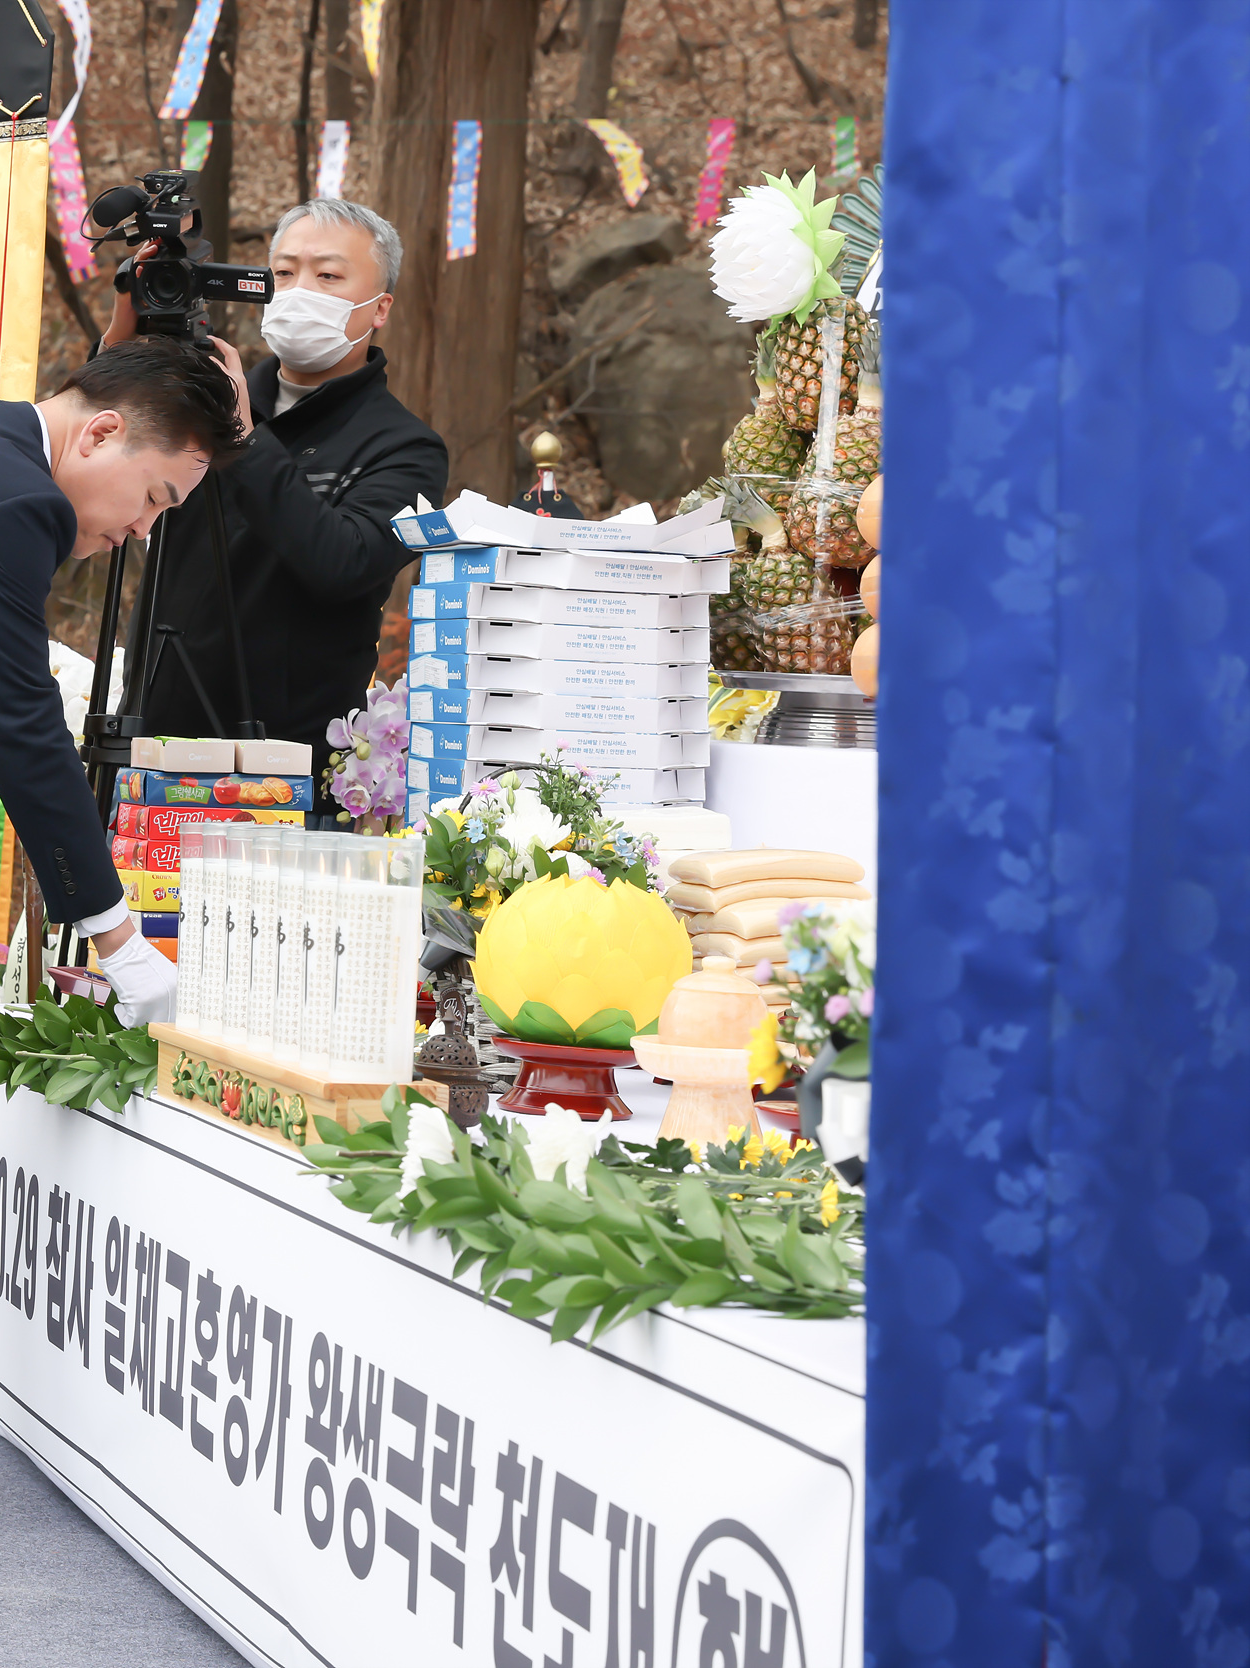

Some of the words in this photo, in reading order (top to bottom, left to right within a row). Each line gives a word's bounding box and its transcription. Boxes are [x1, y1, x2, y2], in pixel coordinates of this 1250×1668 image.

[239, 280, 264, 291] BTN
[468, 564, 490, 574] Domino's
[445, 599, 462, 609] Domino's
[448, 670, 461, 680] mino's
[445, 740, 462, 750] Domino's
[153, 811, 204, 836] 빅파이
[46, 1184, 95, 1369] 참사
[105, 1216, 293, 1515] 일체고혼영가
[304, 1332, 475, 1650] 왕생극락
